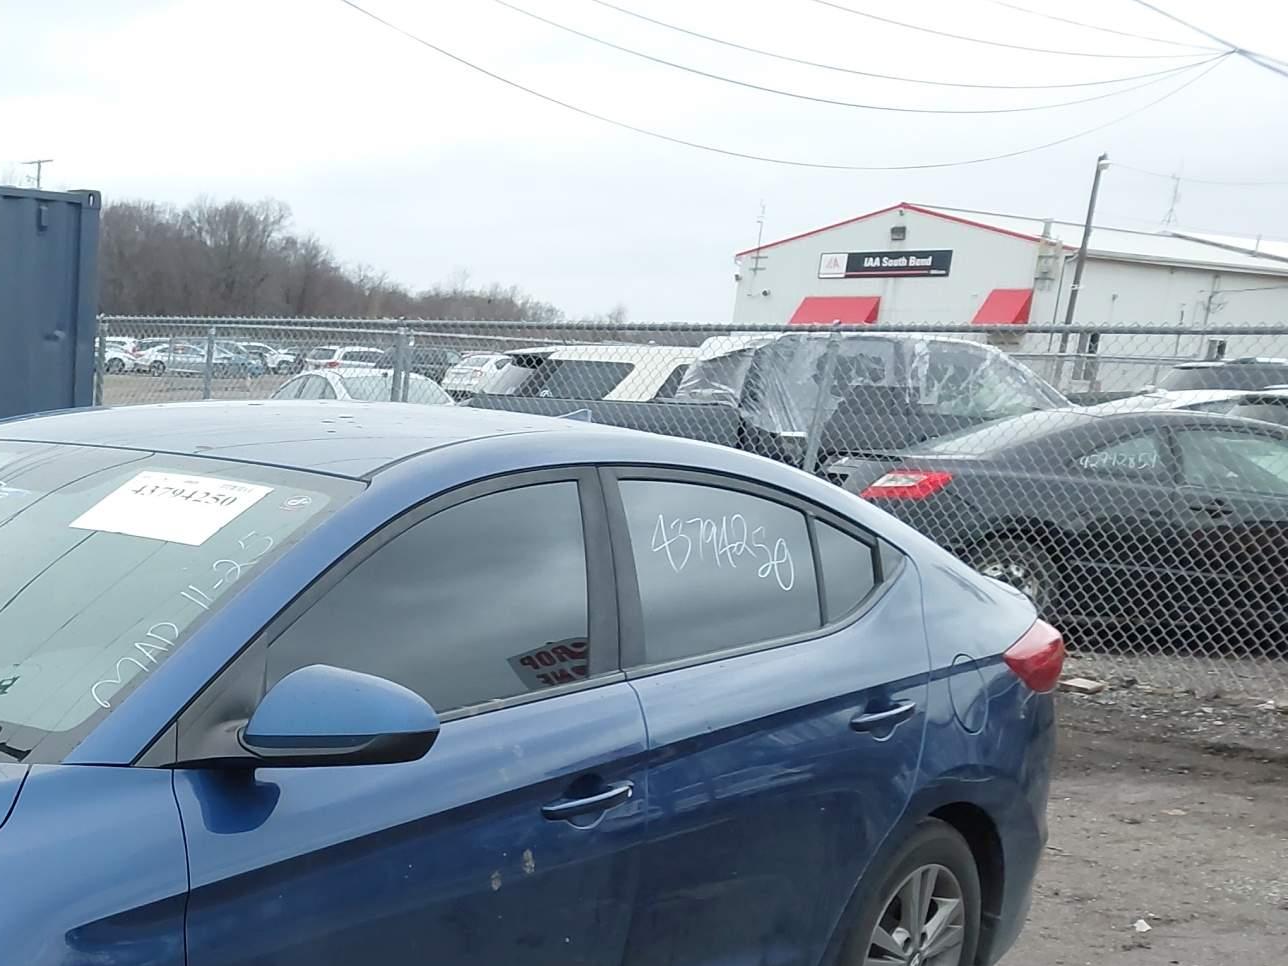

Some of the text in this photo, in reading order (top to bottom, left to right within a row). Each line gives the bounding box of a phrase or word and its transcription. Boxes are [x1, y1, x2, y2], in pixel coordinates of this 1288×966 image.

[863, 255, 933, 268] IAA South Bend
[651, 513, 795, 591] 43794250
